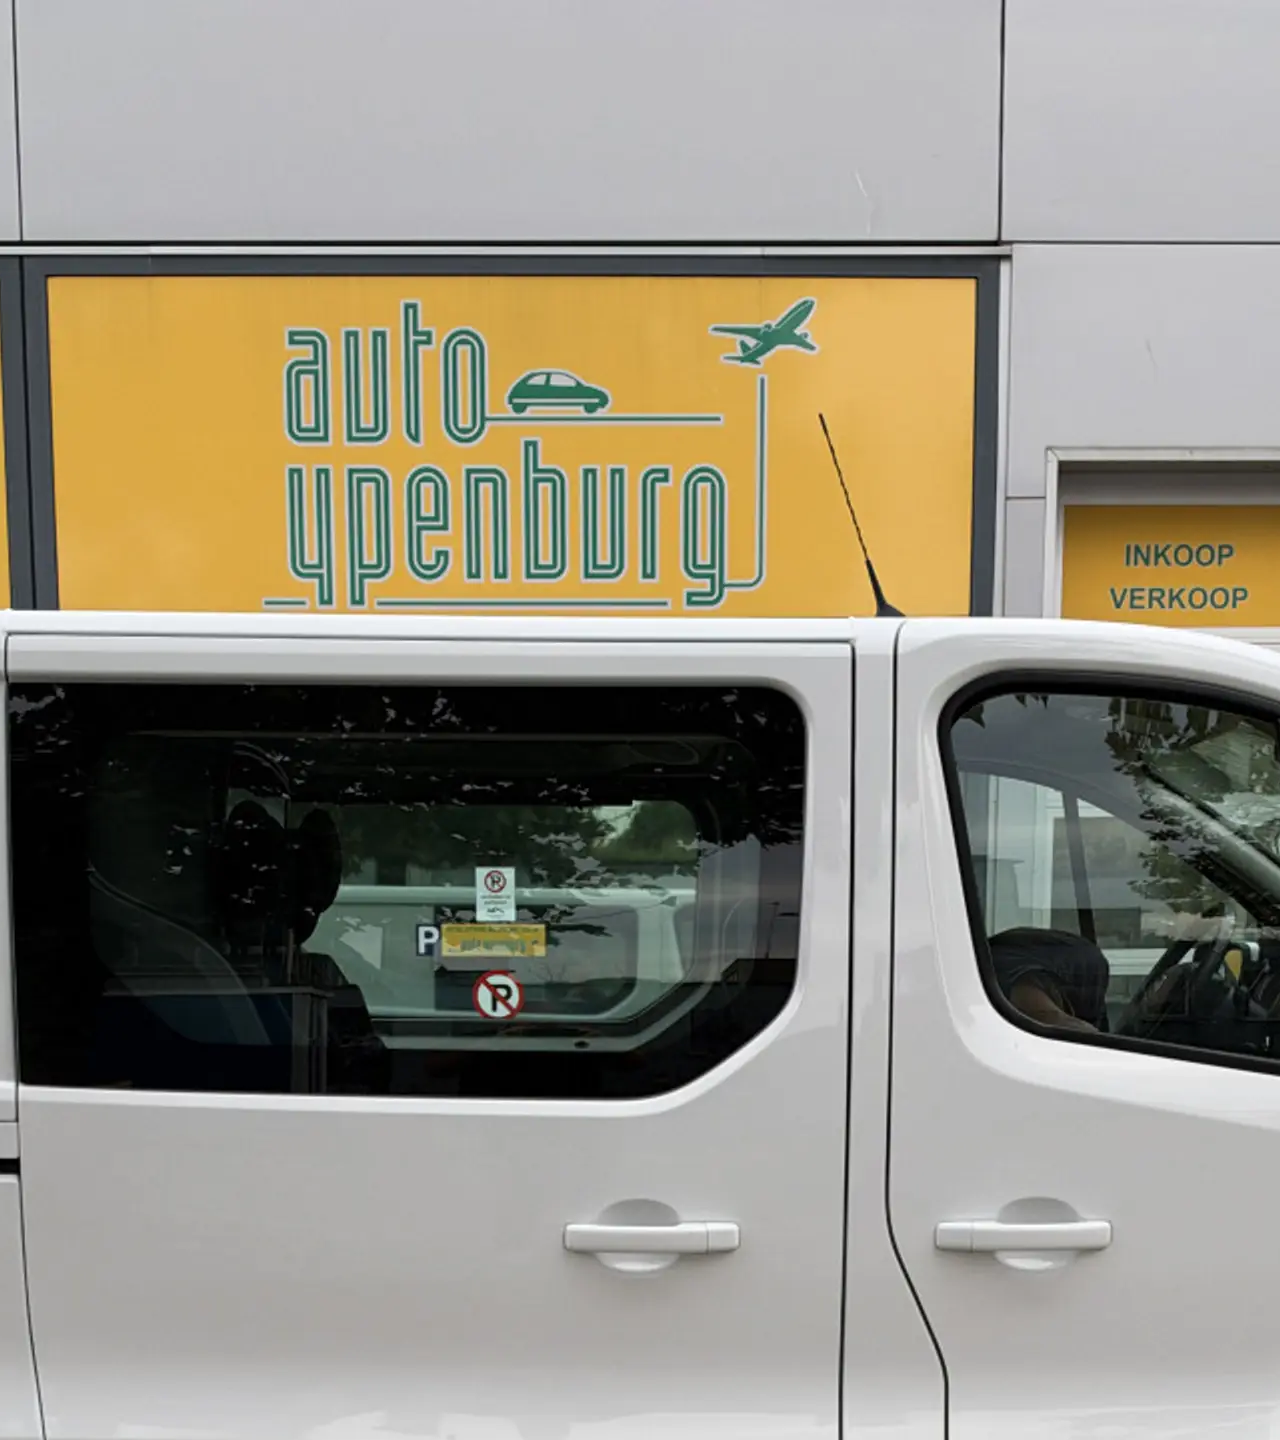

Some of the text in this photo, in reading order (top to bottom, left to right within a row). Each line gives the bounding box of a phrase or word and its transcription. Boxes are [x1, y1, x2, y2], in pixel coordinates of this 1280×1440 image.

[284, 300, 488, 444] auto
[286, 438, 725, 607] ypenburg
[1124, 543, 1235, 567] INKOOP
[1109, 587, 1249, 610] VERKOOP
[418, 925, 440, 955] P
